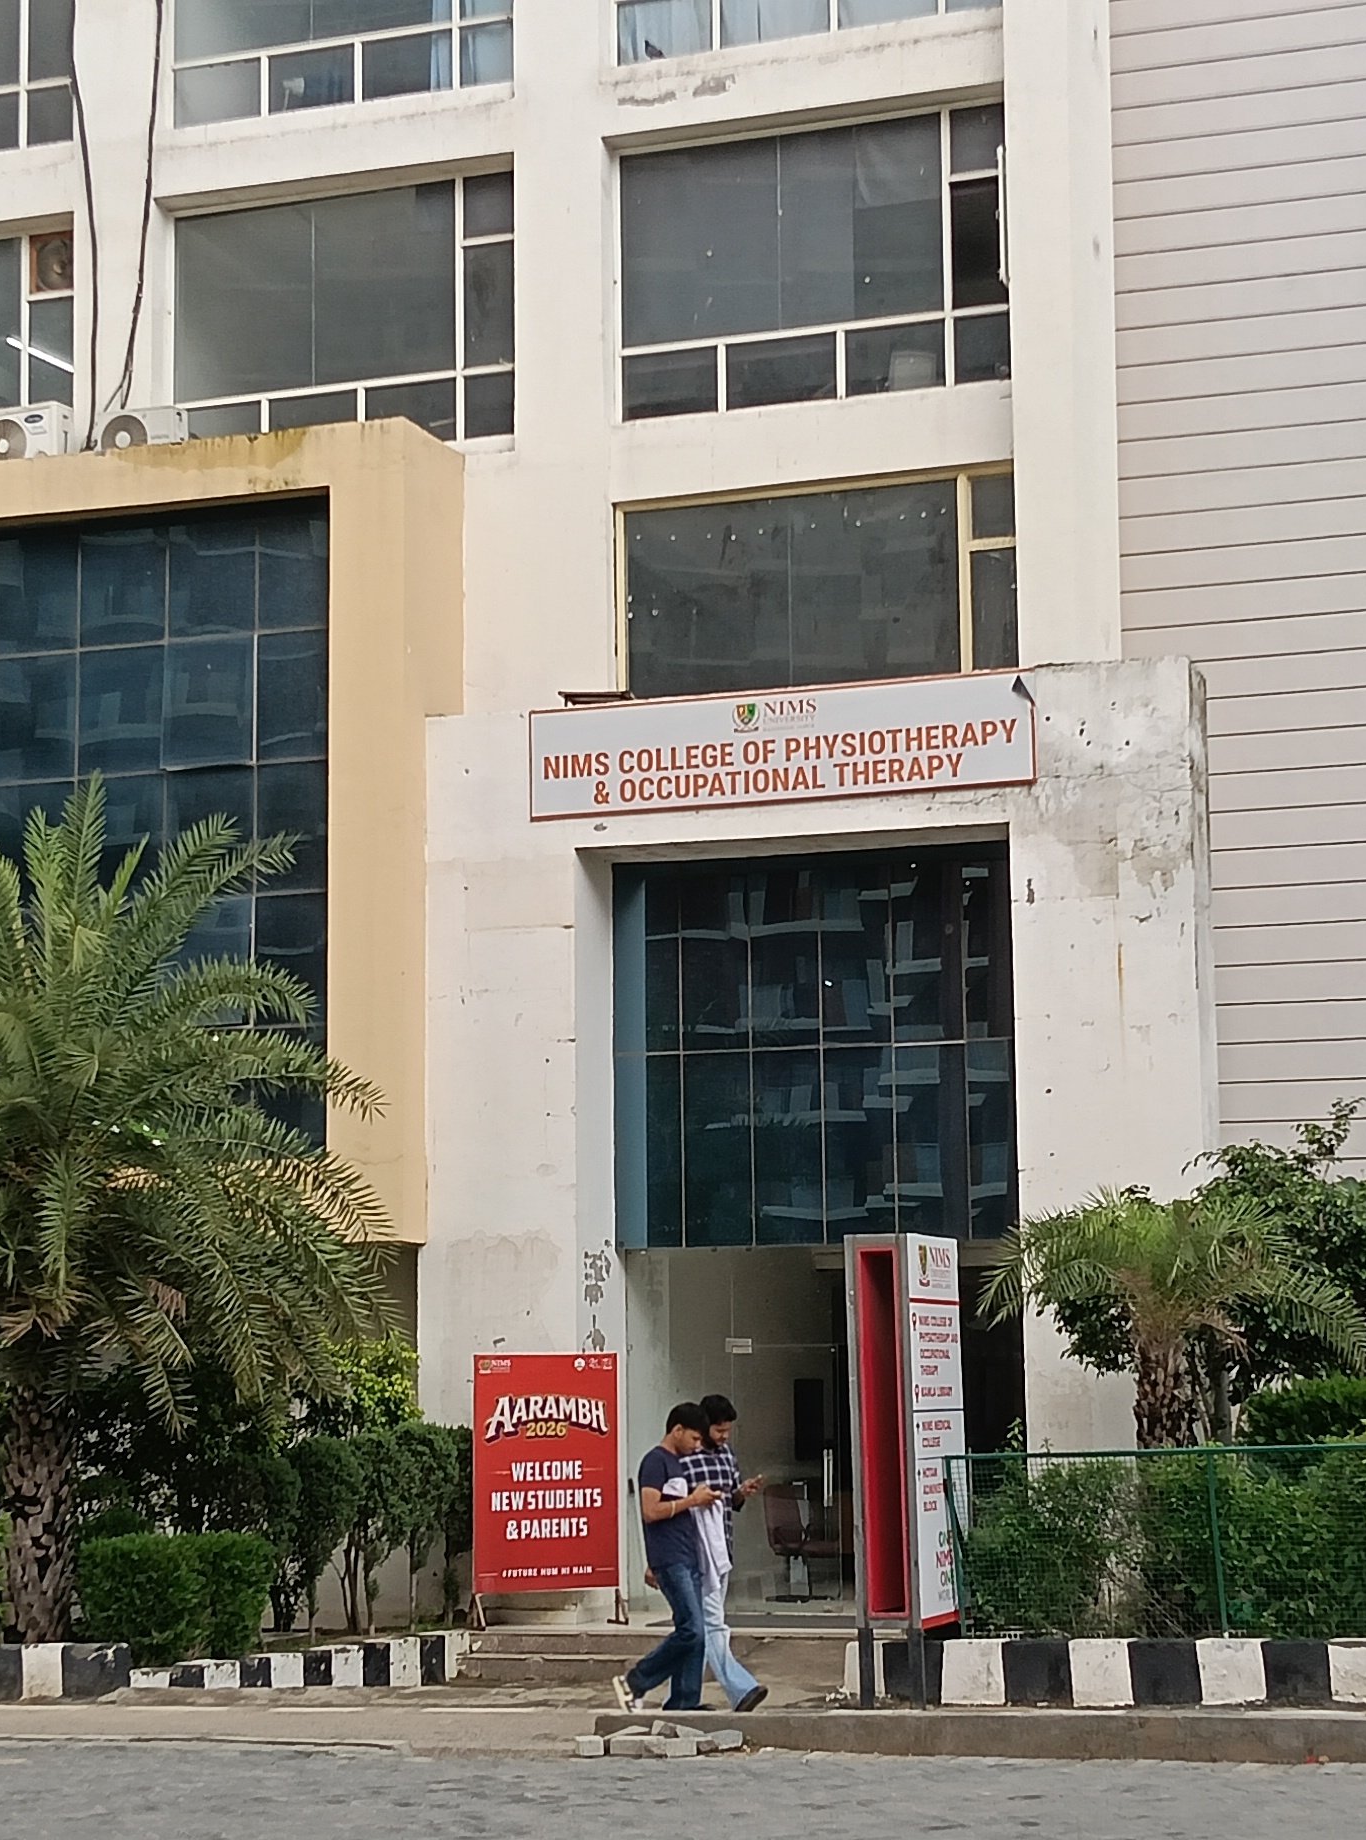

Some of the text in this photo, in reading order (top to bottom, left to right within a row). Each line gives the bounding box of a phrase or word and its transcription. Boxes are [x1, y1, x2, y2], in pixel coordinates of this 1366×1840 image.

[763, 698, 817, 717] NIMS
[763, 714, 815, 724] UNIVERSITY
[542, 718, 1018, 780] NIMS COLLEGE OF PHYSIOTHERAPY
[593, 752, 963, 805] & OCCUPATIONAL THERAPY
[929, 1246, 951, 1268] NIMS
[486, 1394, 609, 1441] AARAMBH
[525, 1421, 567, 1438] 2026
[511, 1460, 583, 1482] WELCOME
[491, 1488, 603, 1512] NEW STUDENTS
[506, 1517, 588, 1540] & PARENTS
[502, 1568, 538, 1578] #FUTURE
